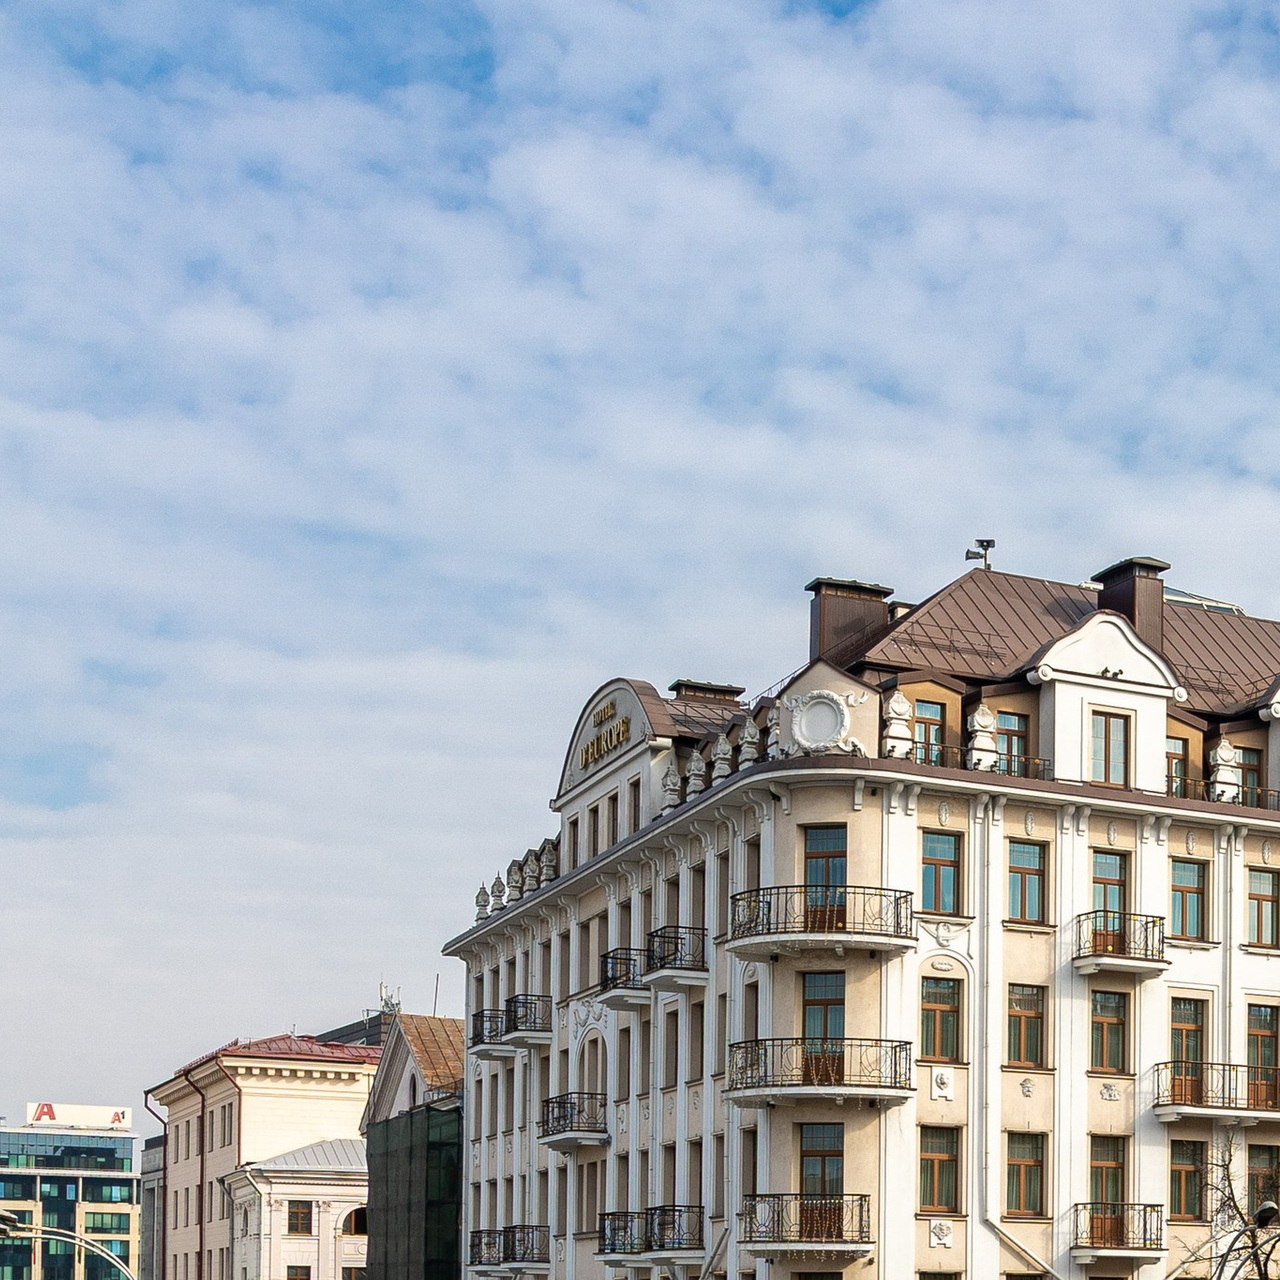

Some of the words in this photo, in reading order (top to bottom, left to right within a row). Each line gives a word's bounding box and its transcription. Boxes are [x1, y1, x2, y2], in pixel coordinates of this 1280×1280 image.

[592, 701, 615, 728] HOTEL
[580, 715, 629, 770] D'EUROPE
[111, 1110, 125, 1124] A1
